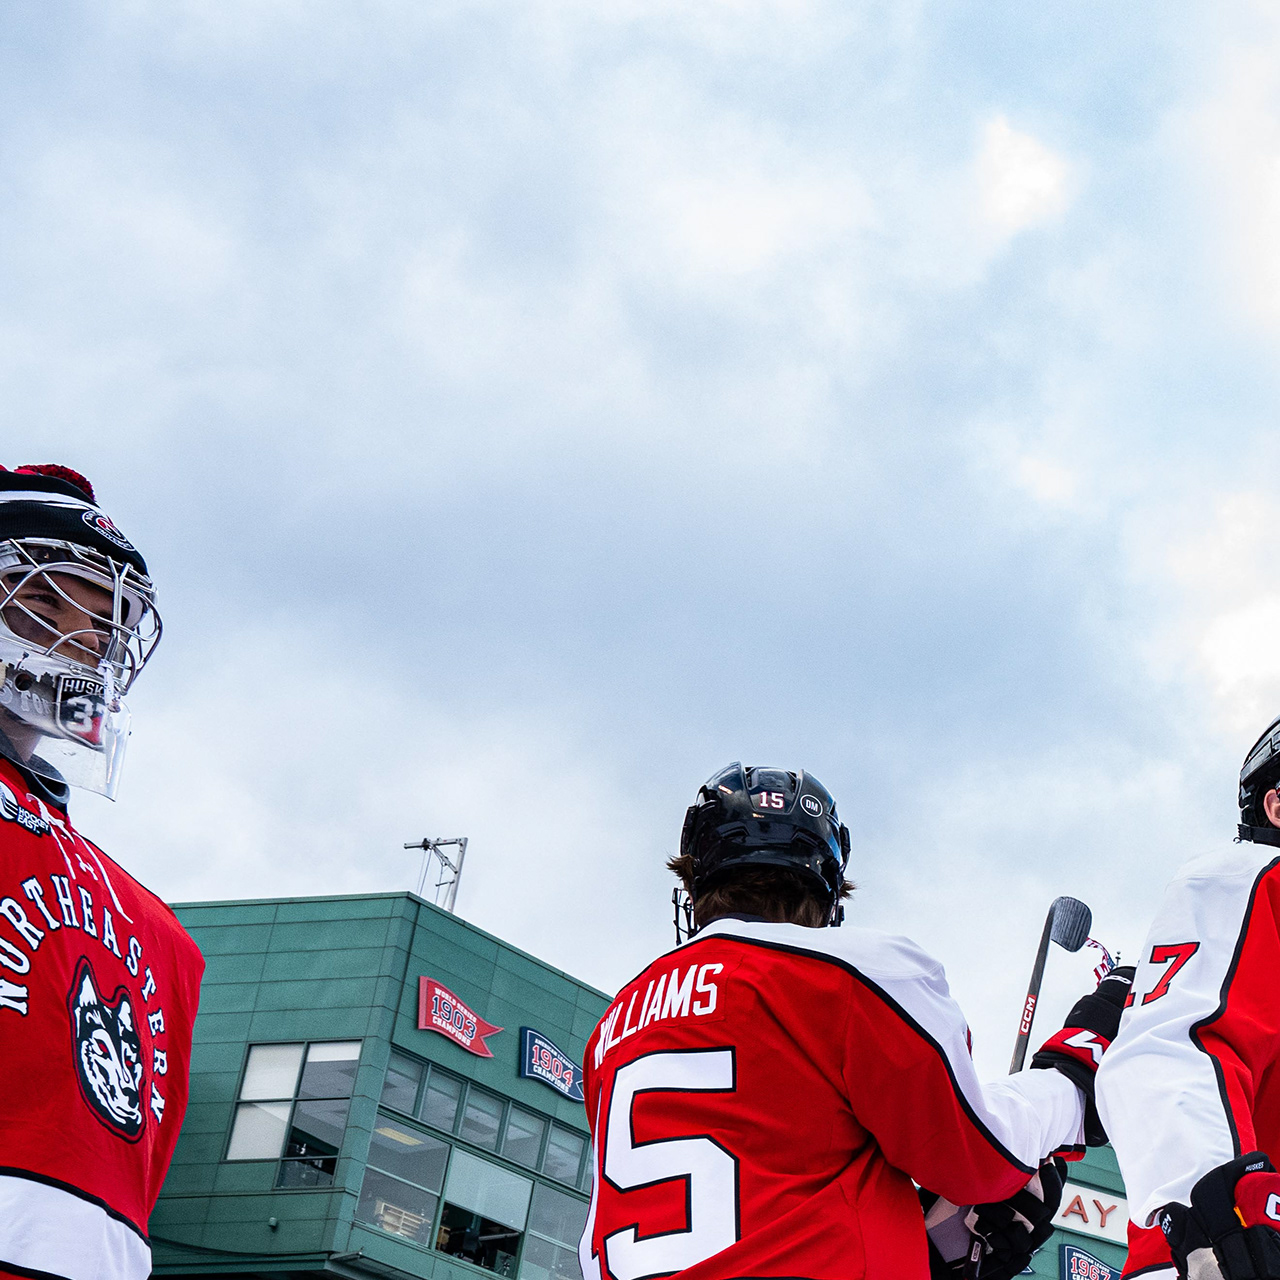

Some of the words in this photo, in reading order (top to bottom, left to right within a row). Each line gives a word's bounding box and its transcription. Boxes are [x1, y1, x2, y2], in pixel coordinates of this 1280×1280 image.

[758, 791, 785, 810] 15
[805, 799, 819, 813] DM
[16, 813, 41, 835] EAST
[17, 805, 51, 832] HOCKEY
[434, 986, 456, 1007] WORLD
[431, 995, 478, 1040] 1903
[594, 962, 725, 1071] WILLIAMS
[1019, 996, 1037, 1034] CCM
[432, 1015, 472, 1047] CHAMPIONS
[531, 1045, 575, 1087] 1904
[533, 1064, 570, 1094] CHAMPIONS
[1245, 1161, 1265, 1172] HUSKIES
